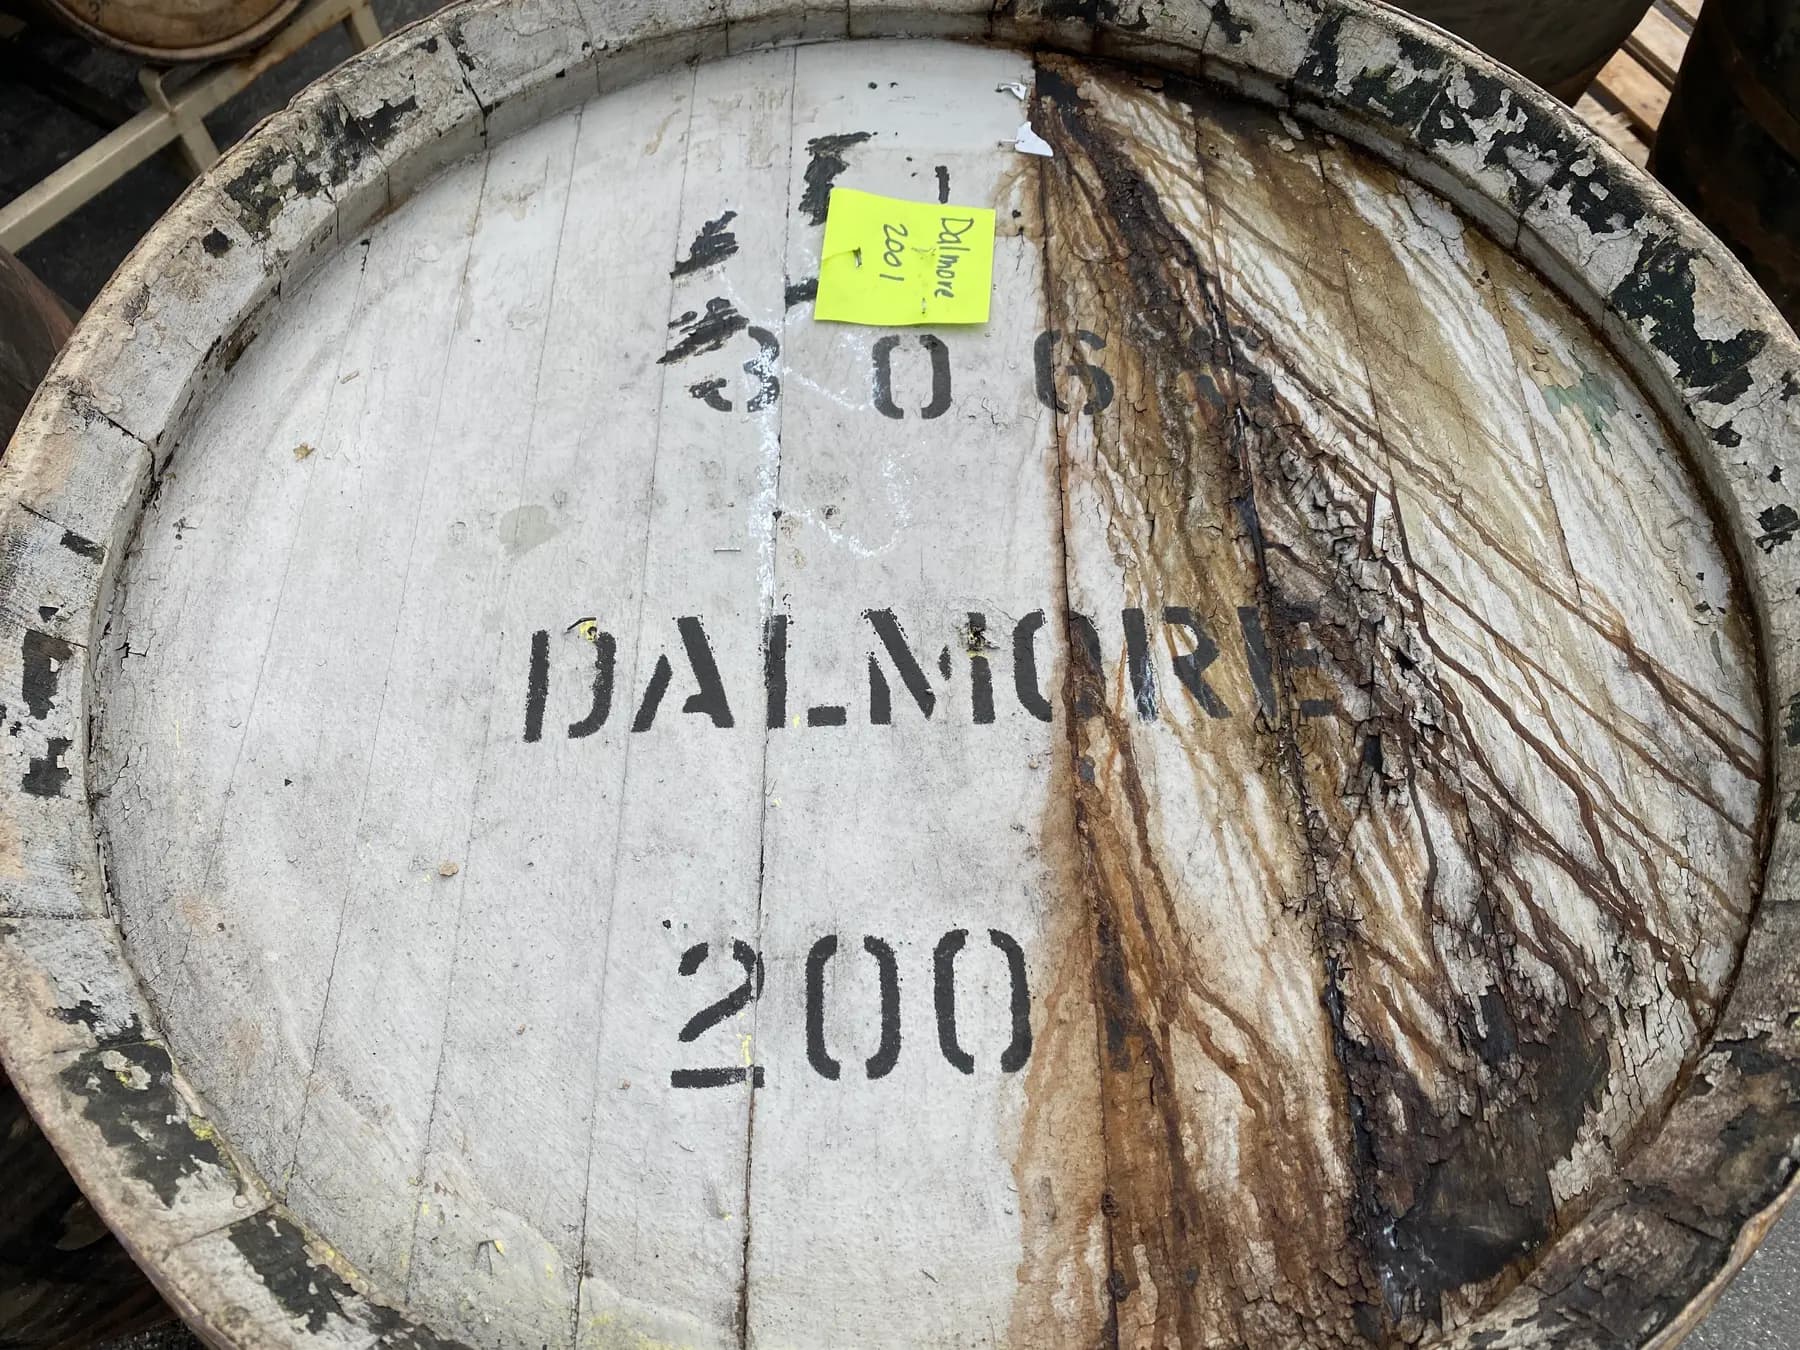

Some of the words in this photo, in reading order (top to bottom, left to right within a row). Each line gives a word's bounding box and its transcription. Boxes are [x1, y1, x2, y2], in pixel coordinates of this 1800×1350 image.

[879, 223, 909, 281] 2001
[934, 217, 975, 298] Dalmore
[524, 603, 1337, 743] DALMORE
